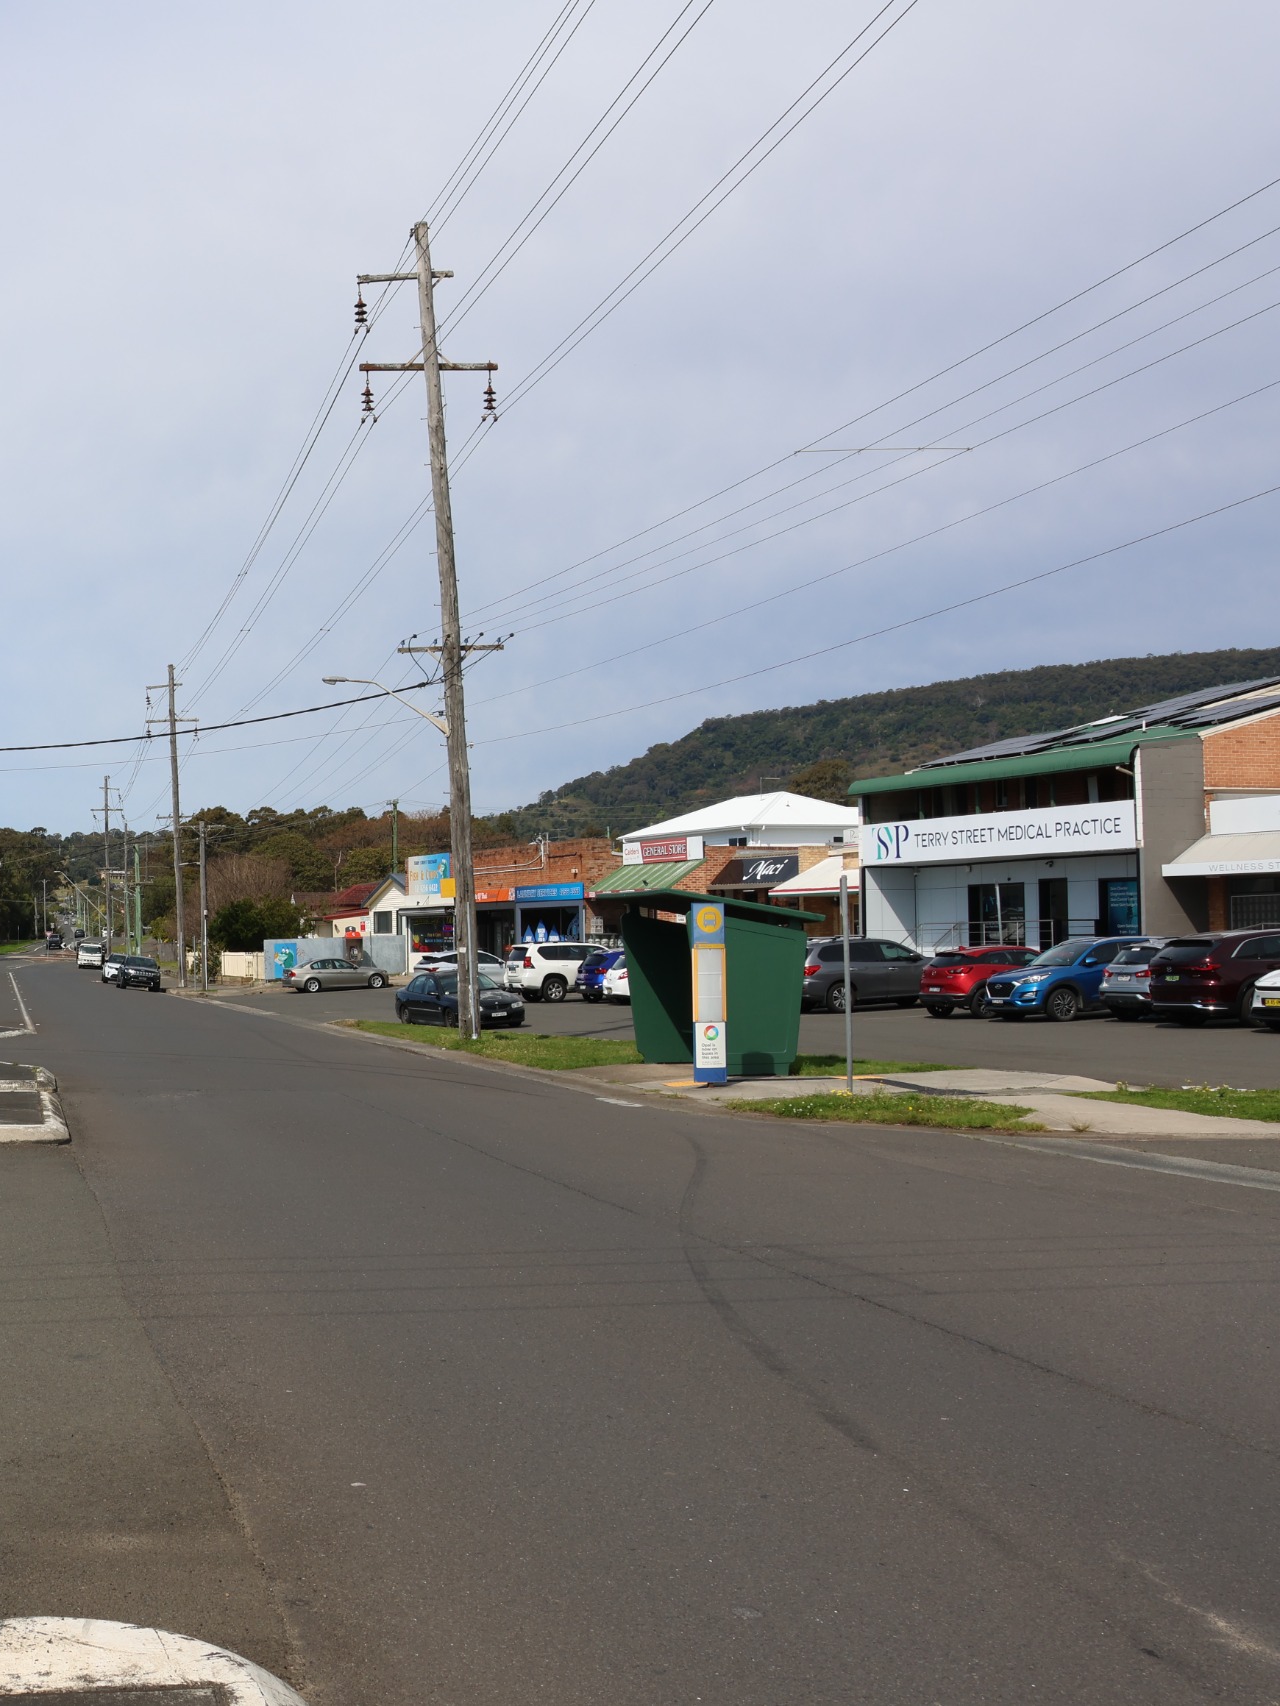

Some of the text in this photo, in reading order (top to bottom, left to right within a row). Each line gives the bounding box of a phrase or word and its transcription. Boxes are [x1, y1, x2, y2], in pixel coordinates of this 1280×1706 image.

[914, 817, 1121, 848] TERRY STREET MEDICAL PRACTICE
[643, 843, 687, 857] GENERAL STORE
[742, 859, 789, 881] Maci
[1208, 863, 1264, 872] WELLNESS
